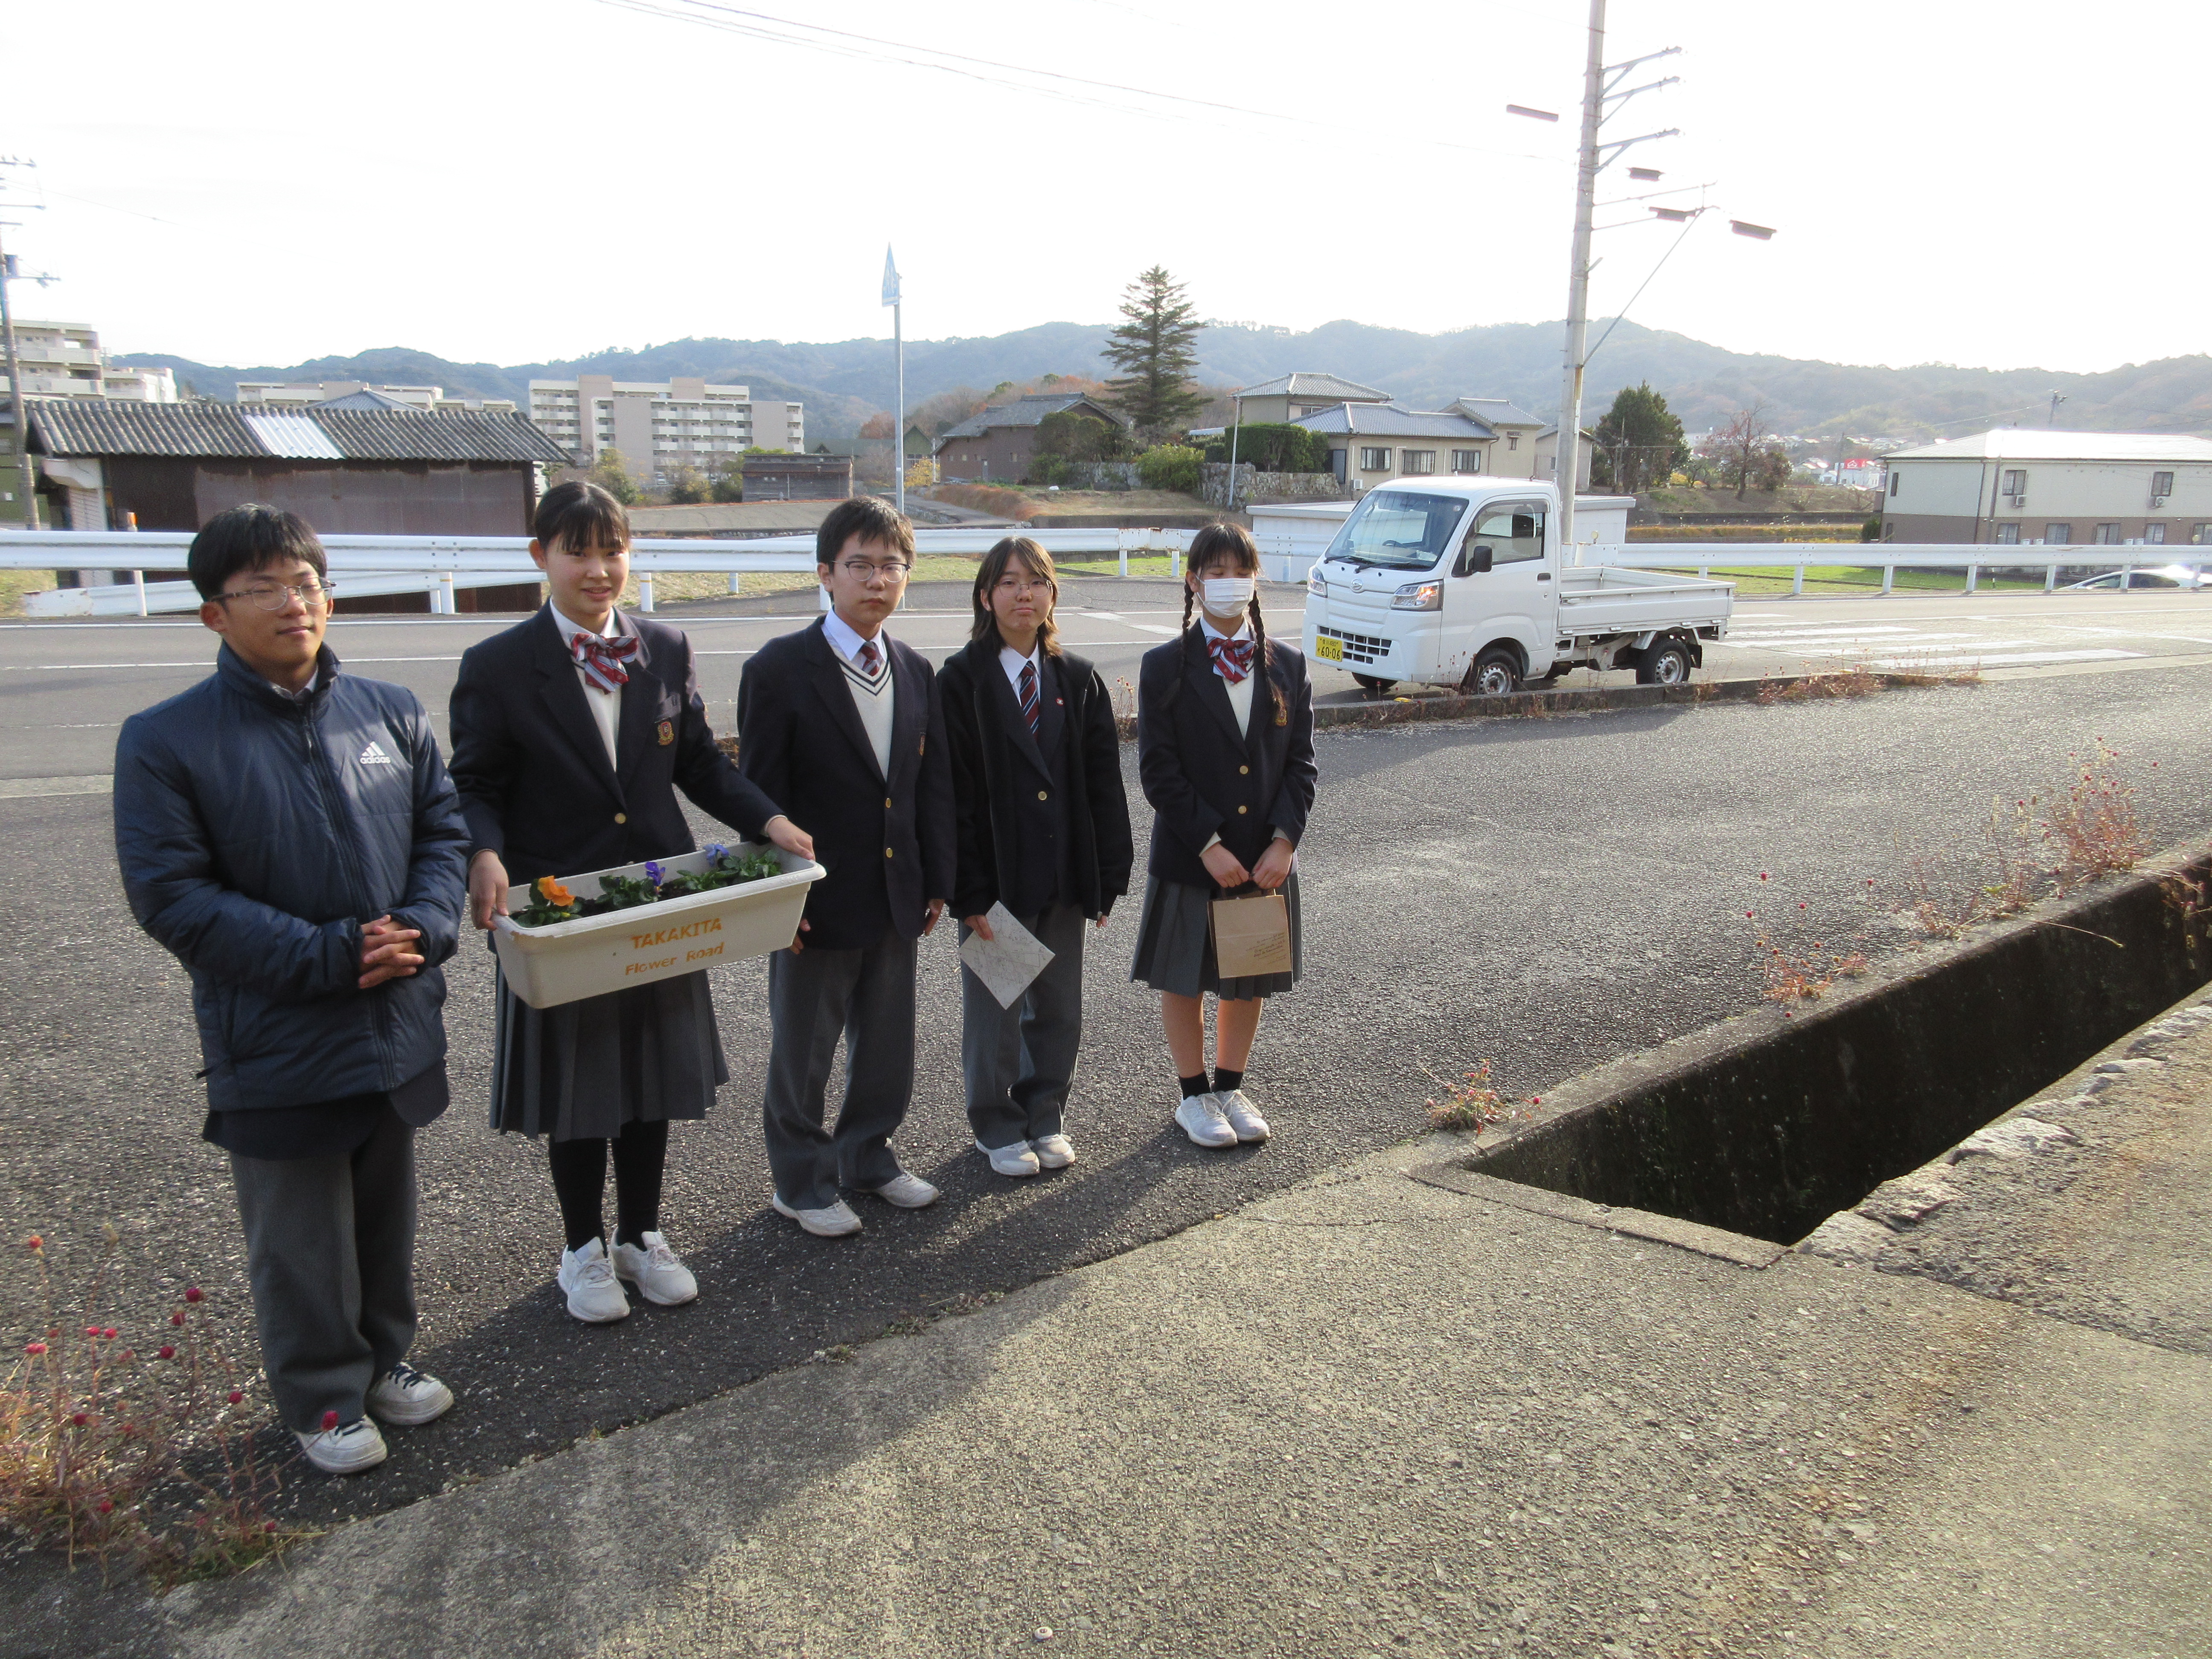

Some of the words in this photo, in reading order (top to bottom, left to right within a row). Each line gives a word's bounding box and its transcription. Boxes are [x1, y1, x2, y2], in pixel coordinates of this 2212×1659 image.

[1321, 646, 1340, 660] 60-06
[632, 918, 722, 949] TAKAKITA
[626, 957, 677, 975] Flower
[686, 942, 724, 961] Road
